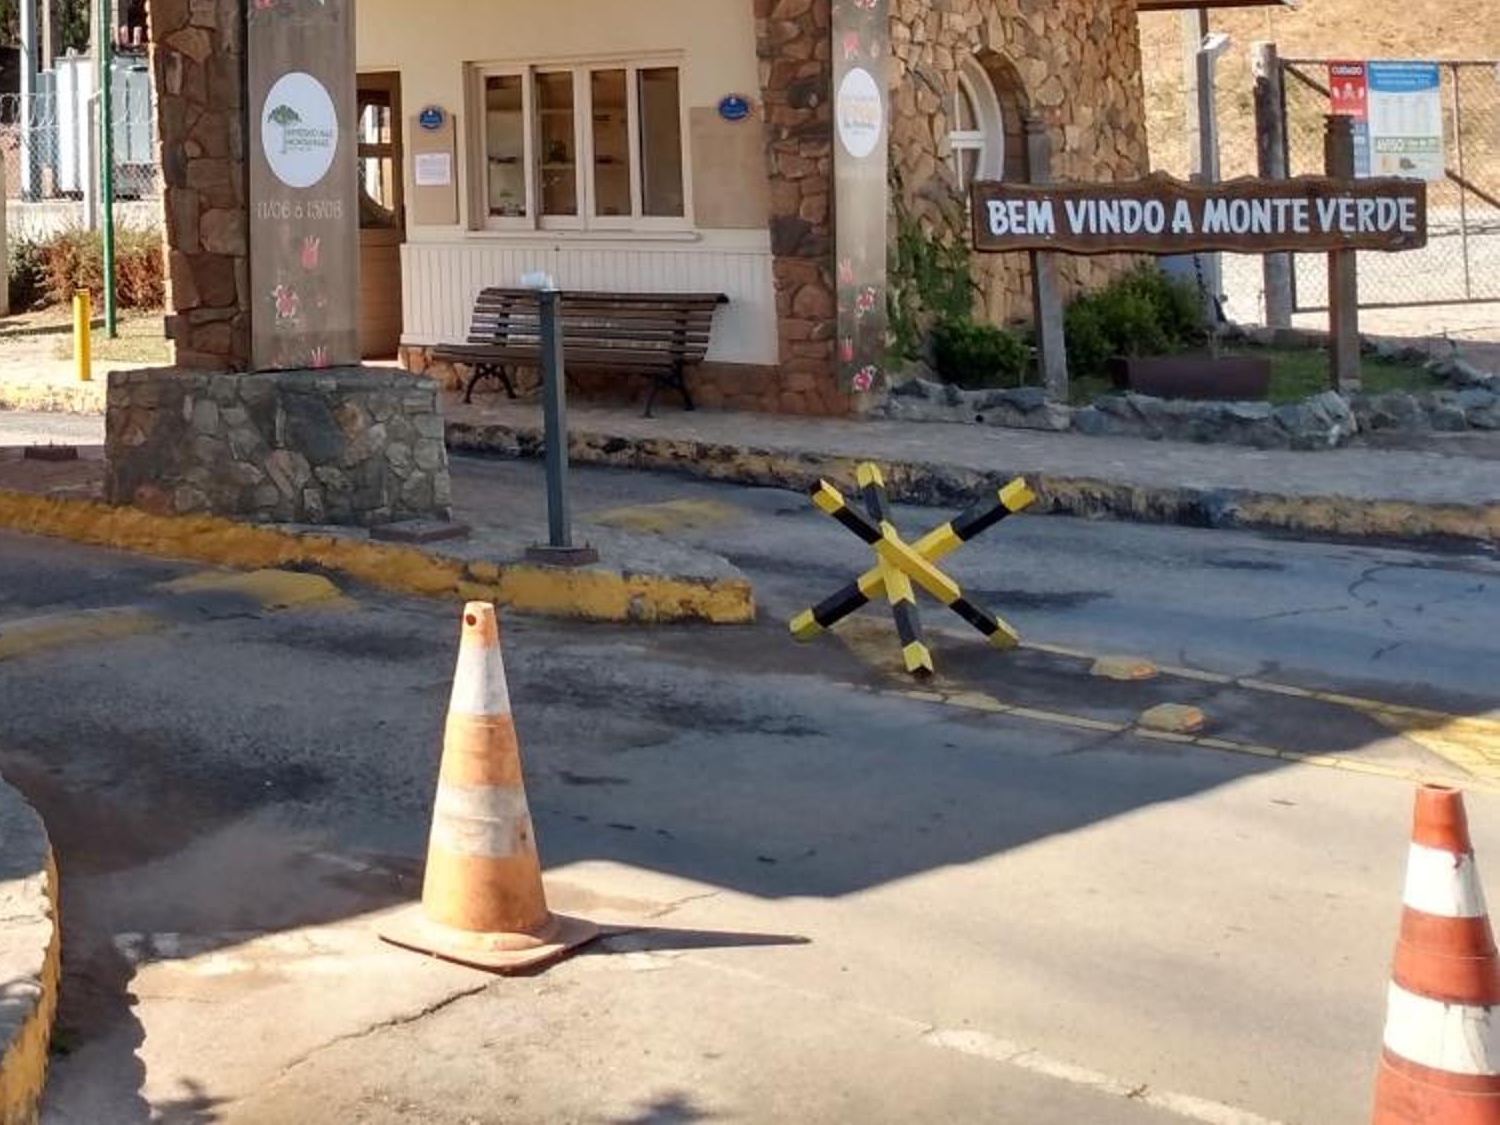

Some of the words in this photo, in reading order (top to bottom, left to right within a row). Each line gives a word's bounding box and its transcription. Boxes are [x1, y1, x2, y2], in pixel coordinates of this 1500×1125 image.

[986, 199, 1055, 235] BEM
[1064, 199, 1165, 235] VINDO
[1172, 200, 1194, 234] A
[1202, 197, 1309, 234] MONTE
[1315, 196, 1417, 233] VERDE
